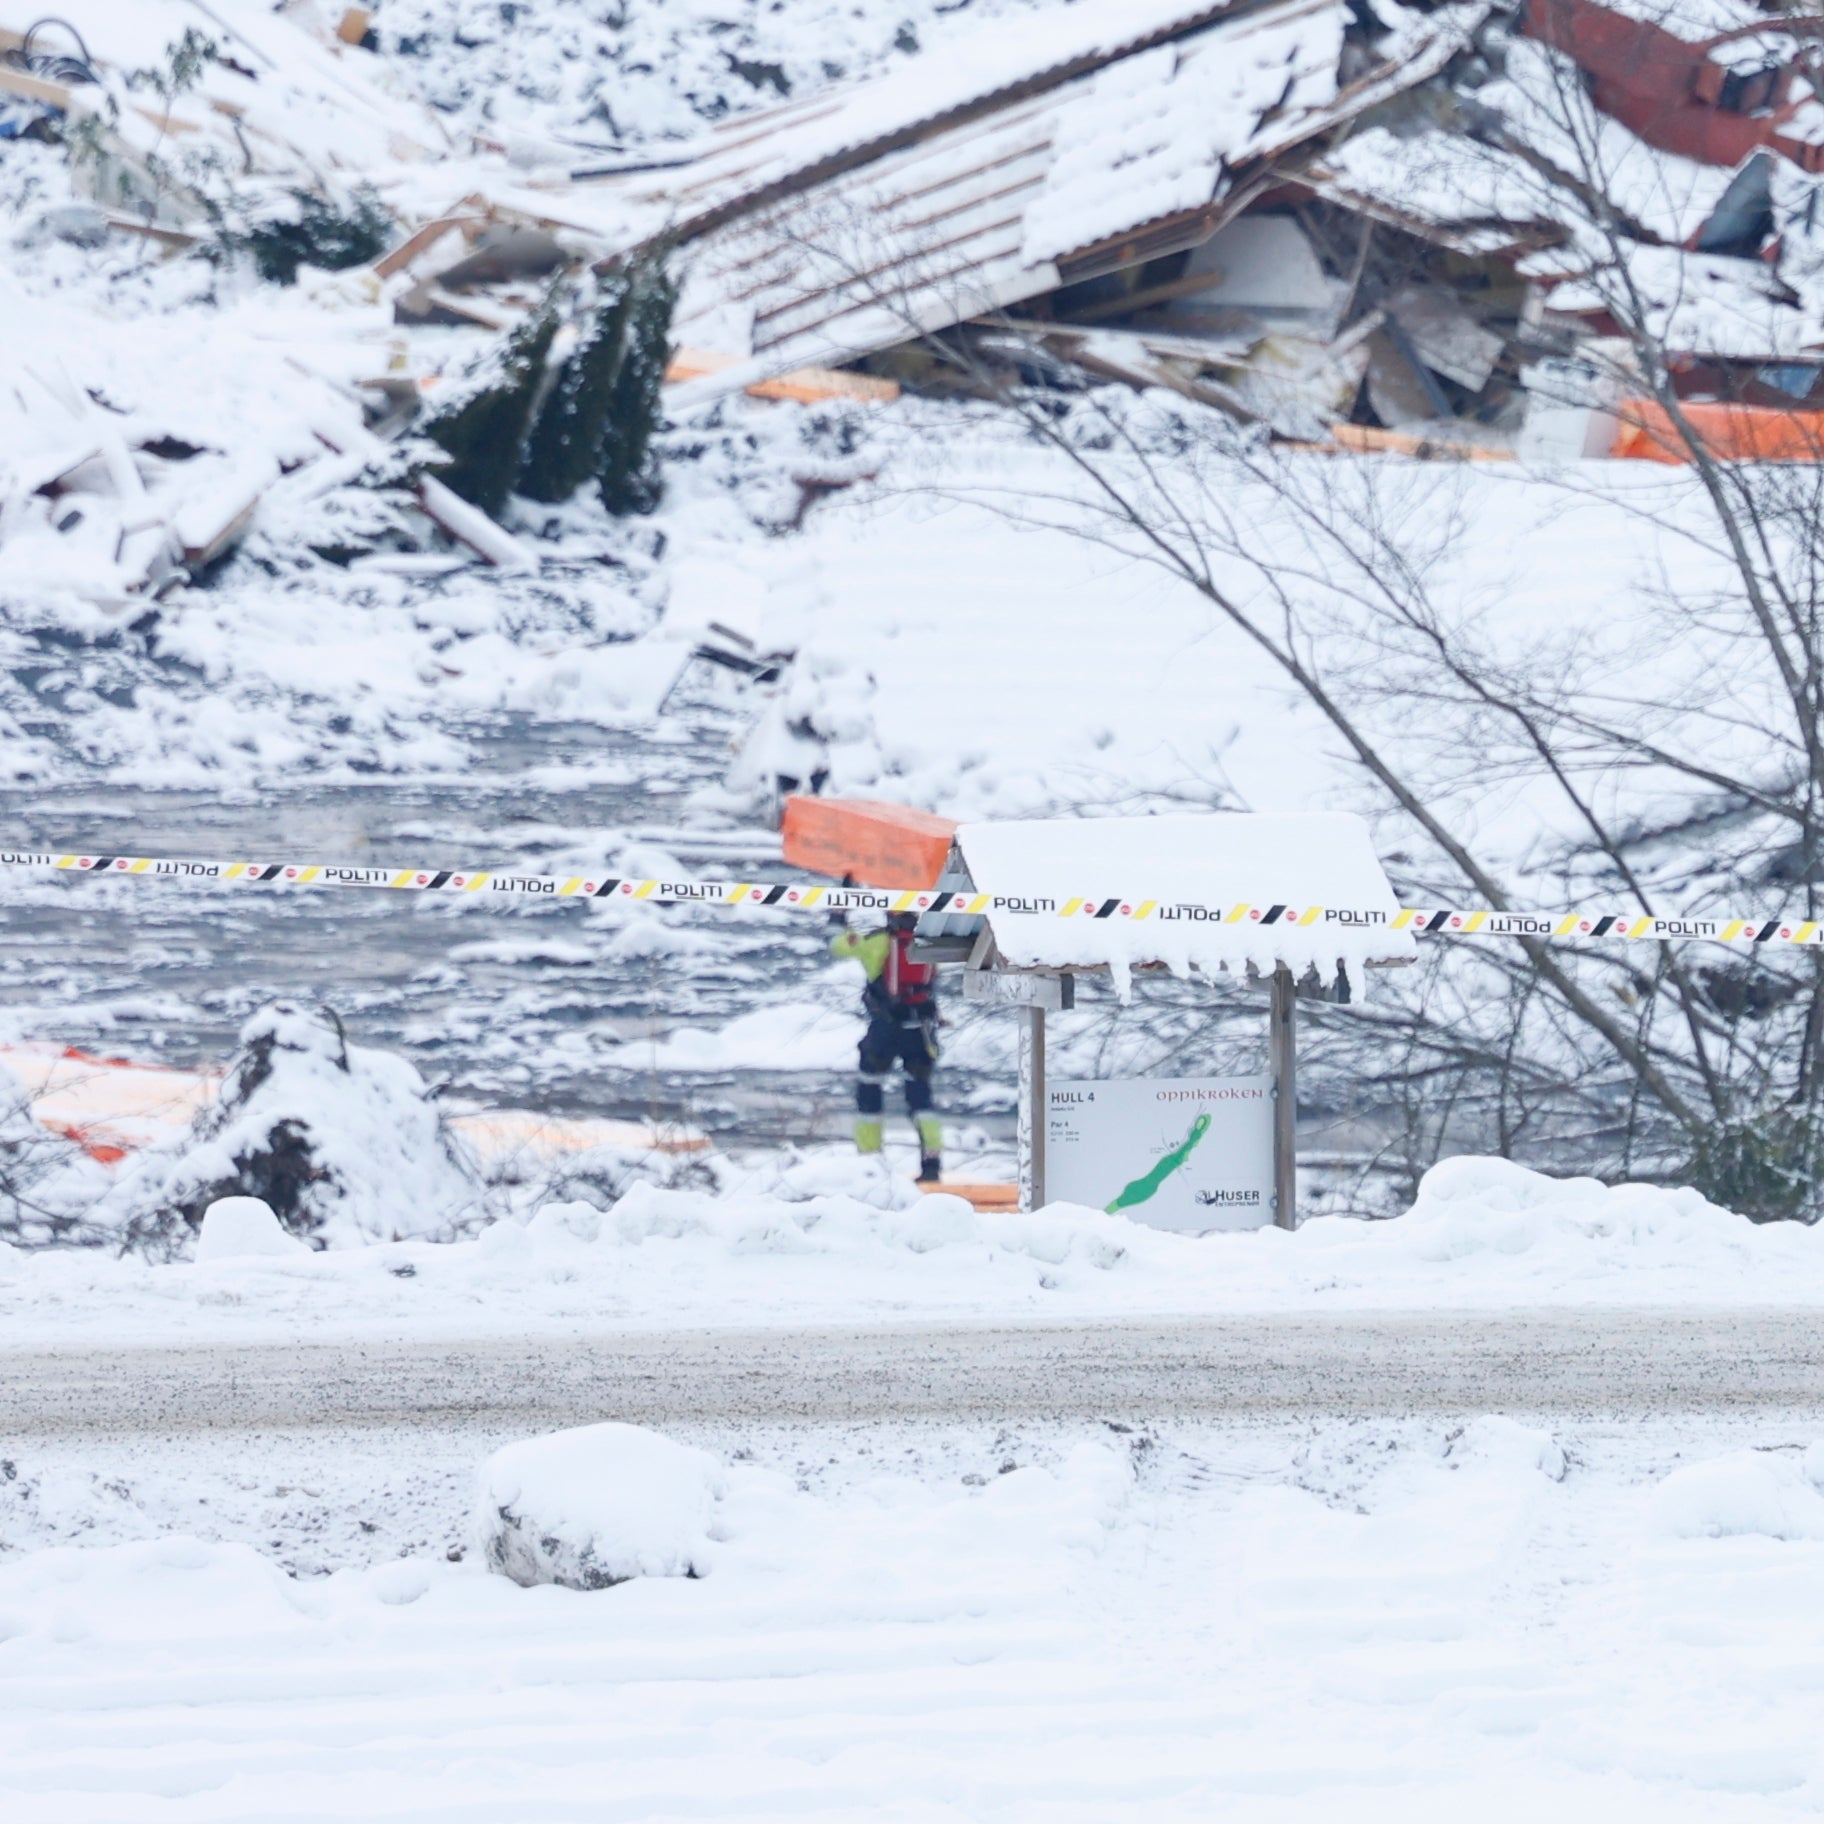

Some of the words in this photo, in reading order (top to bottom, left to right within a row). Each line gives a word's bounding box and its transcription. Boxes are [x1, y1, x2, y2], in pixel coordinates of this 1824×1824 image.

[2, 855, 50, 864] OLITI
[156, 863, 219, 876] POLITI
[326, 869, 387, 881] POLITI
[493, 879, 555, 893] POLITI
[661, 884, 722, 897] POLITI
[828, 894, 888, 908] POLITI
[994, 898, 1054, 911] POLITI
[1160, 907, 1220, 920] POLITI
[1326, 910, 1386, 923] POLITI
[1491, 919, 1551, 933] POLITI
[1655, 921, 1715, 934] POLITI
[1051, 1092, 1084, 1103] HULL
[1088, 1092, 1095, 1103] 4
[1215, 1190, 1260, 1201] HUSER
